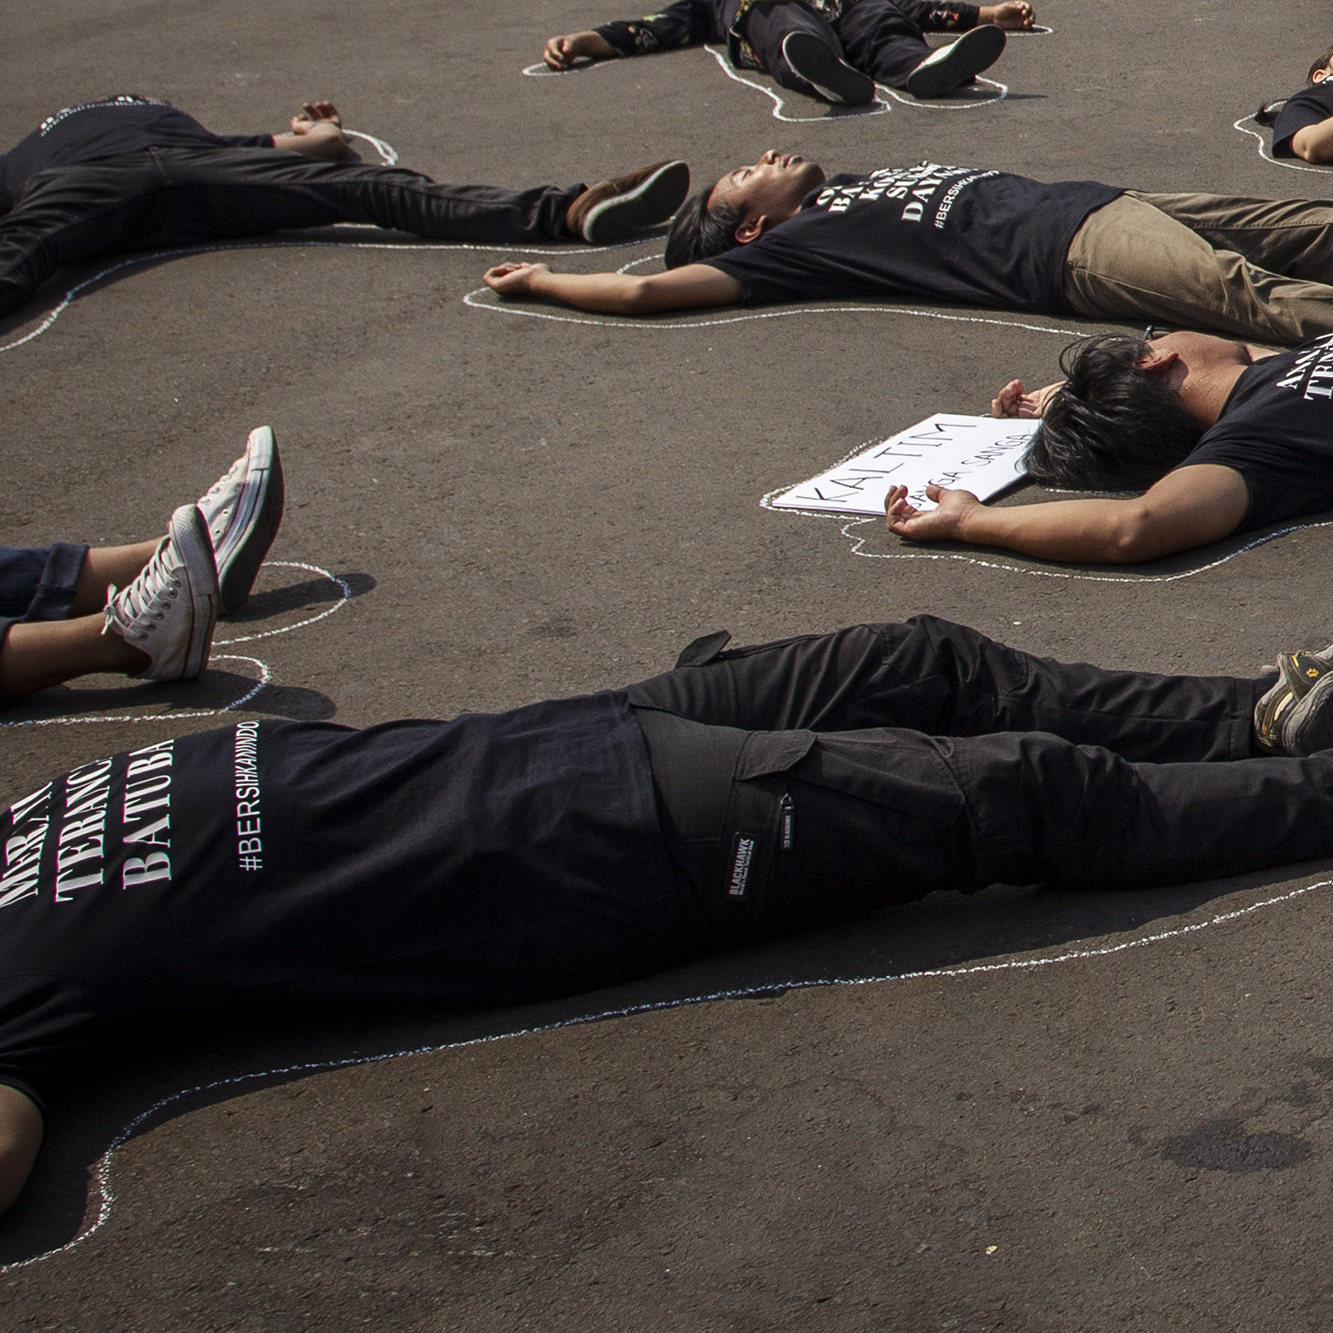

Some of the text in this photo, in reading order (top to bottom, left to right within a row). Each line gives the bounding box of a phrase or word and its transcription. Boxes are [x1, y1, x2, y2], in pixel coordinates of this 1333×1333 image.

[795, 423, 978, 503] KALTIM
[961, 433, 1033, 467] SANGA
[126, 738, 175, 779] BA
[54, 756, 113, 903] TERANC
[235, 720, 263, 872] #BERSIHKANINDO
[729, 837, 750, 896] BLACKHAWK
